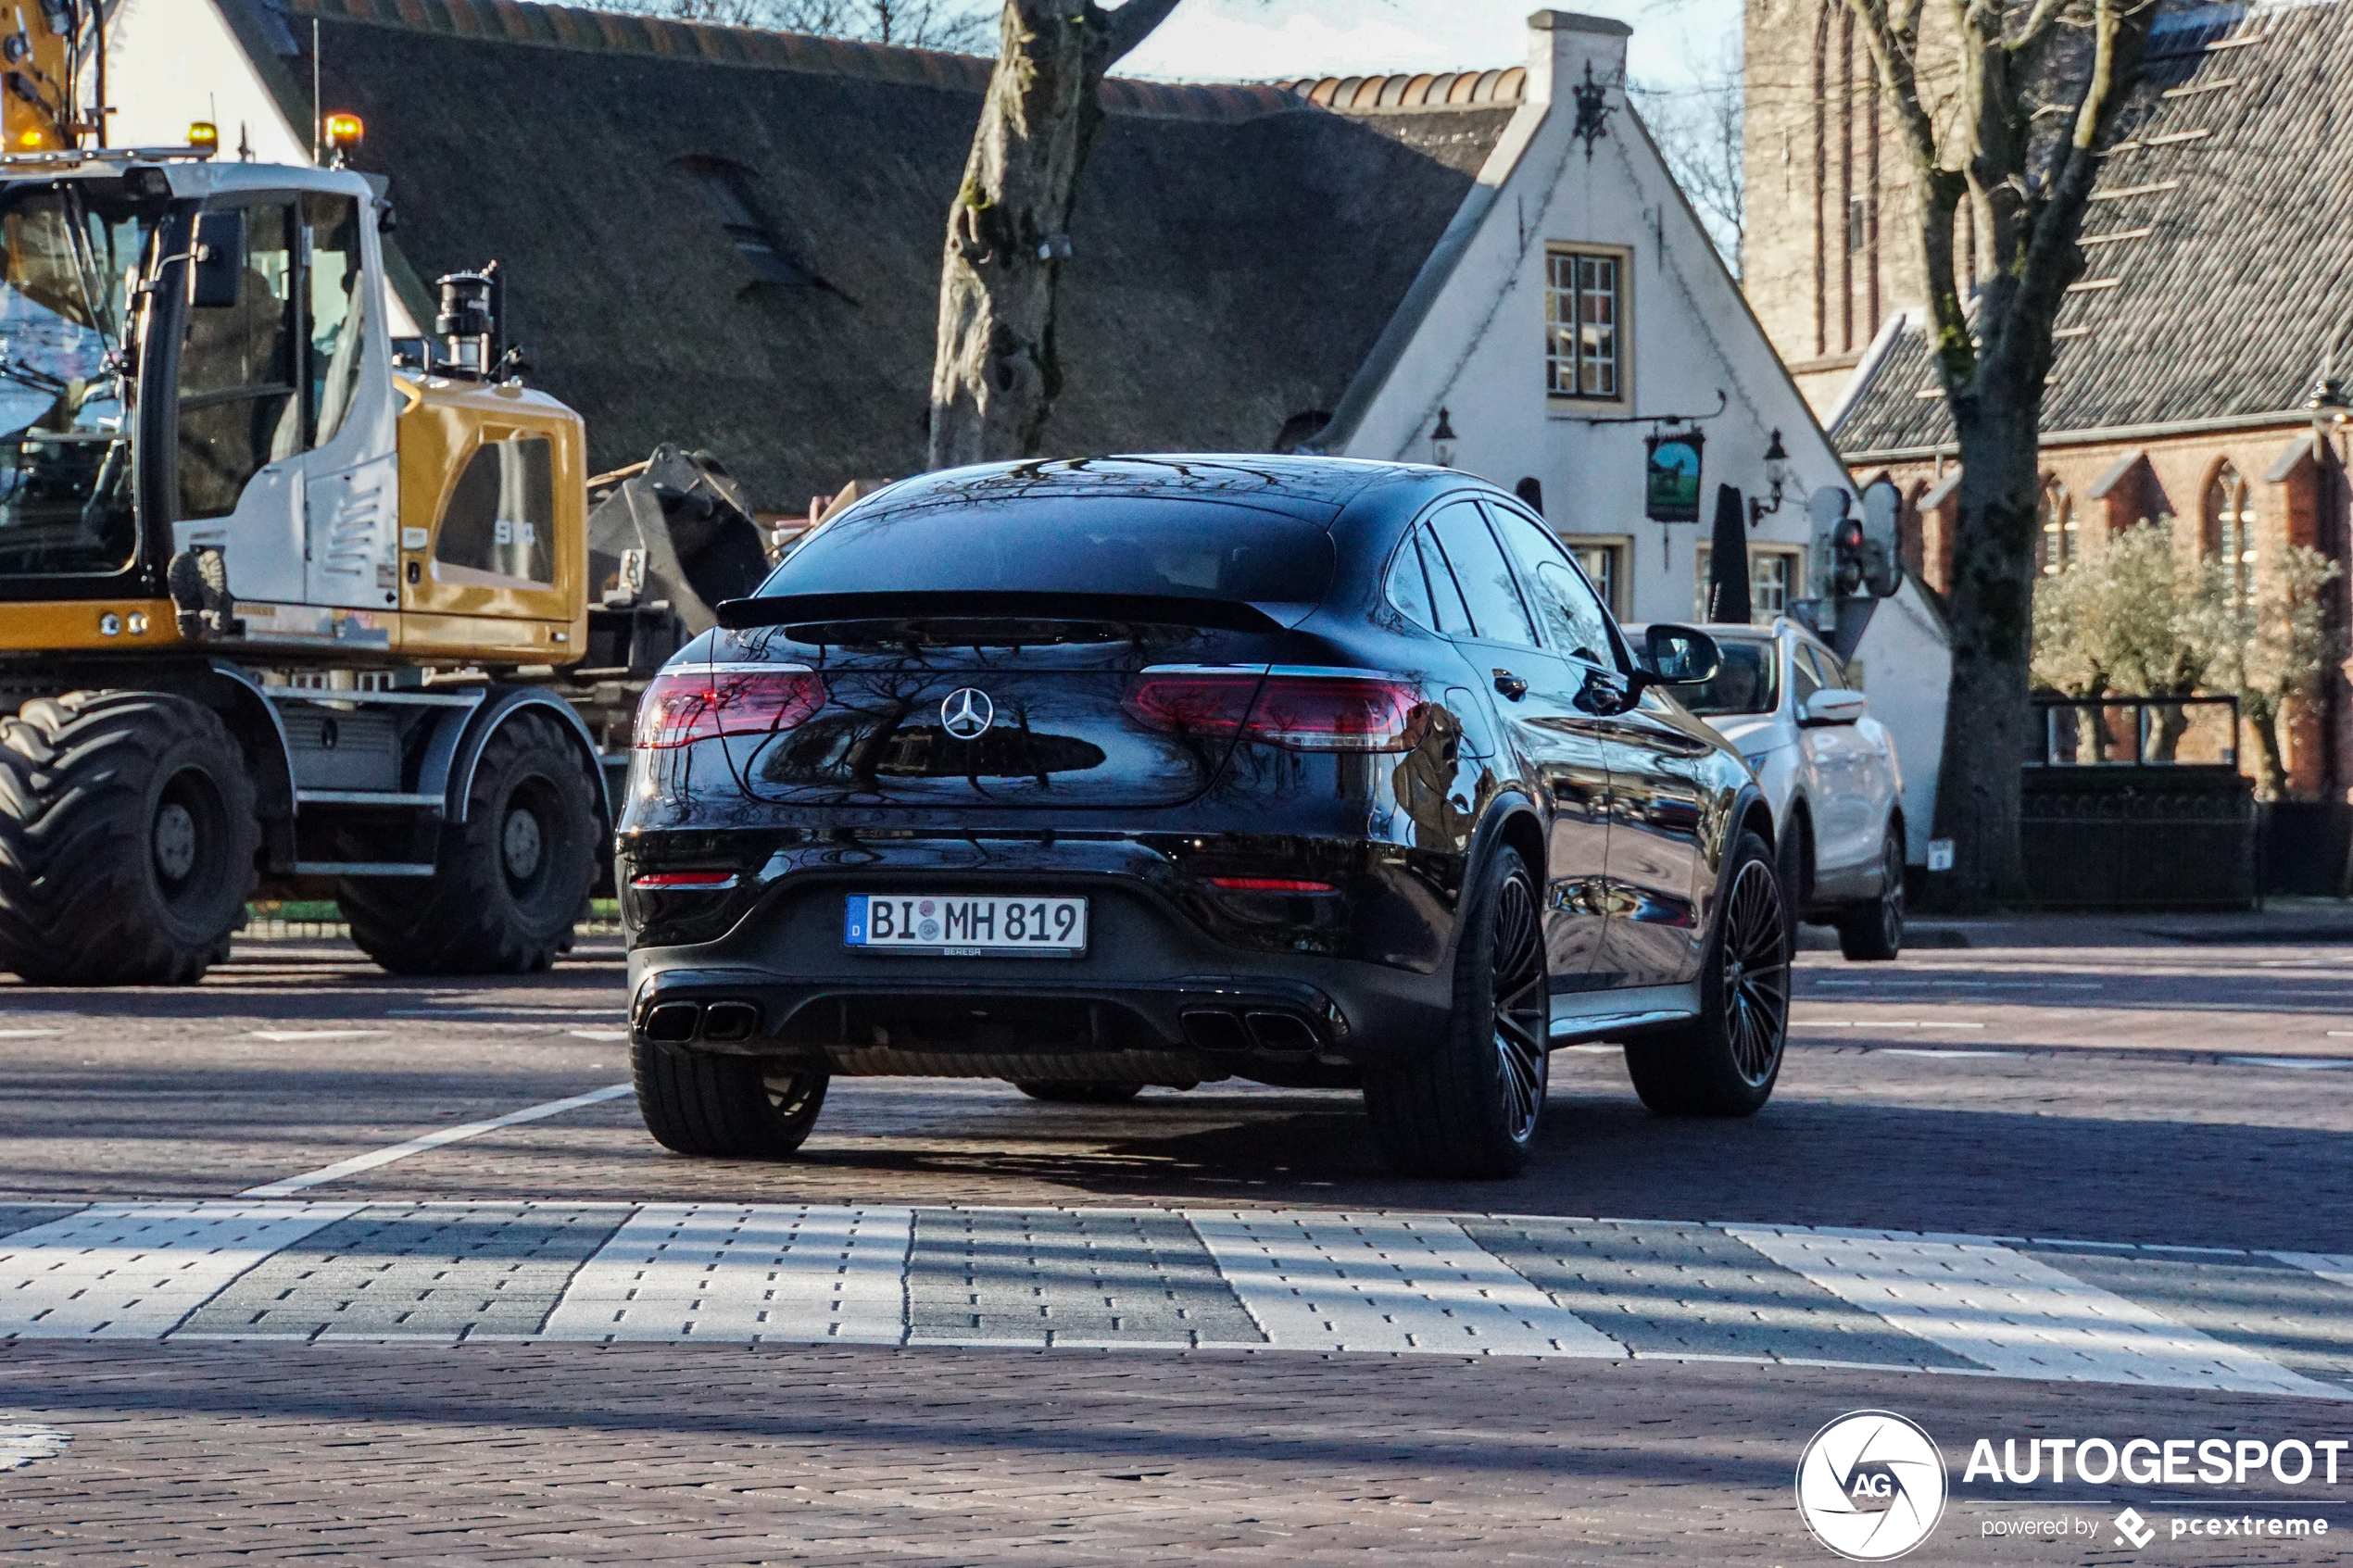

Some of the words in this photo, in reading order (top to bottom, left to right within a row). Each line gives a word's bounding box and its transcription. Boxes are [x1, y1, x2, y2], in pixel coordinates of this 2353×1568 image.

[871, 901, 916, 939] BI
[945, 902, 996, 941] MH
[1004, 903, 1076, 942] 819
[851, 924, 861, 936] D
[943, 947, 982, 956] BERESA
